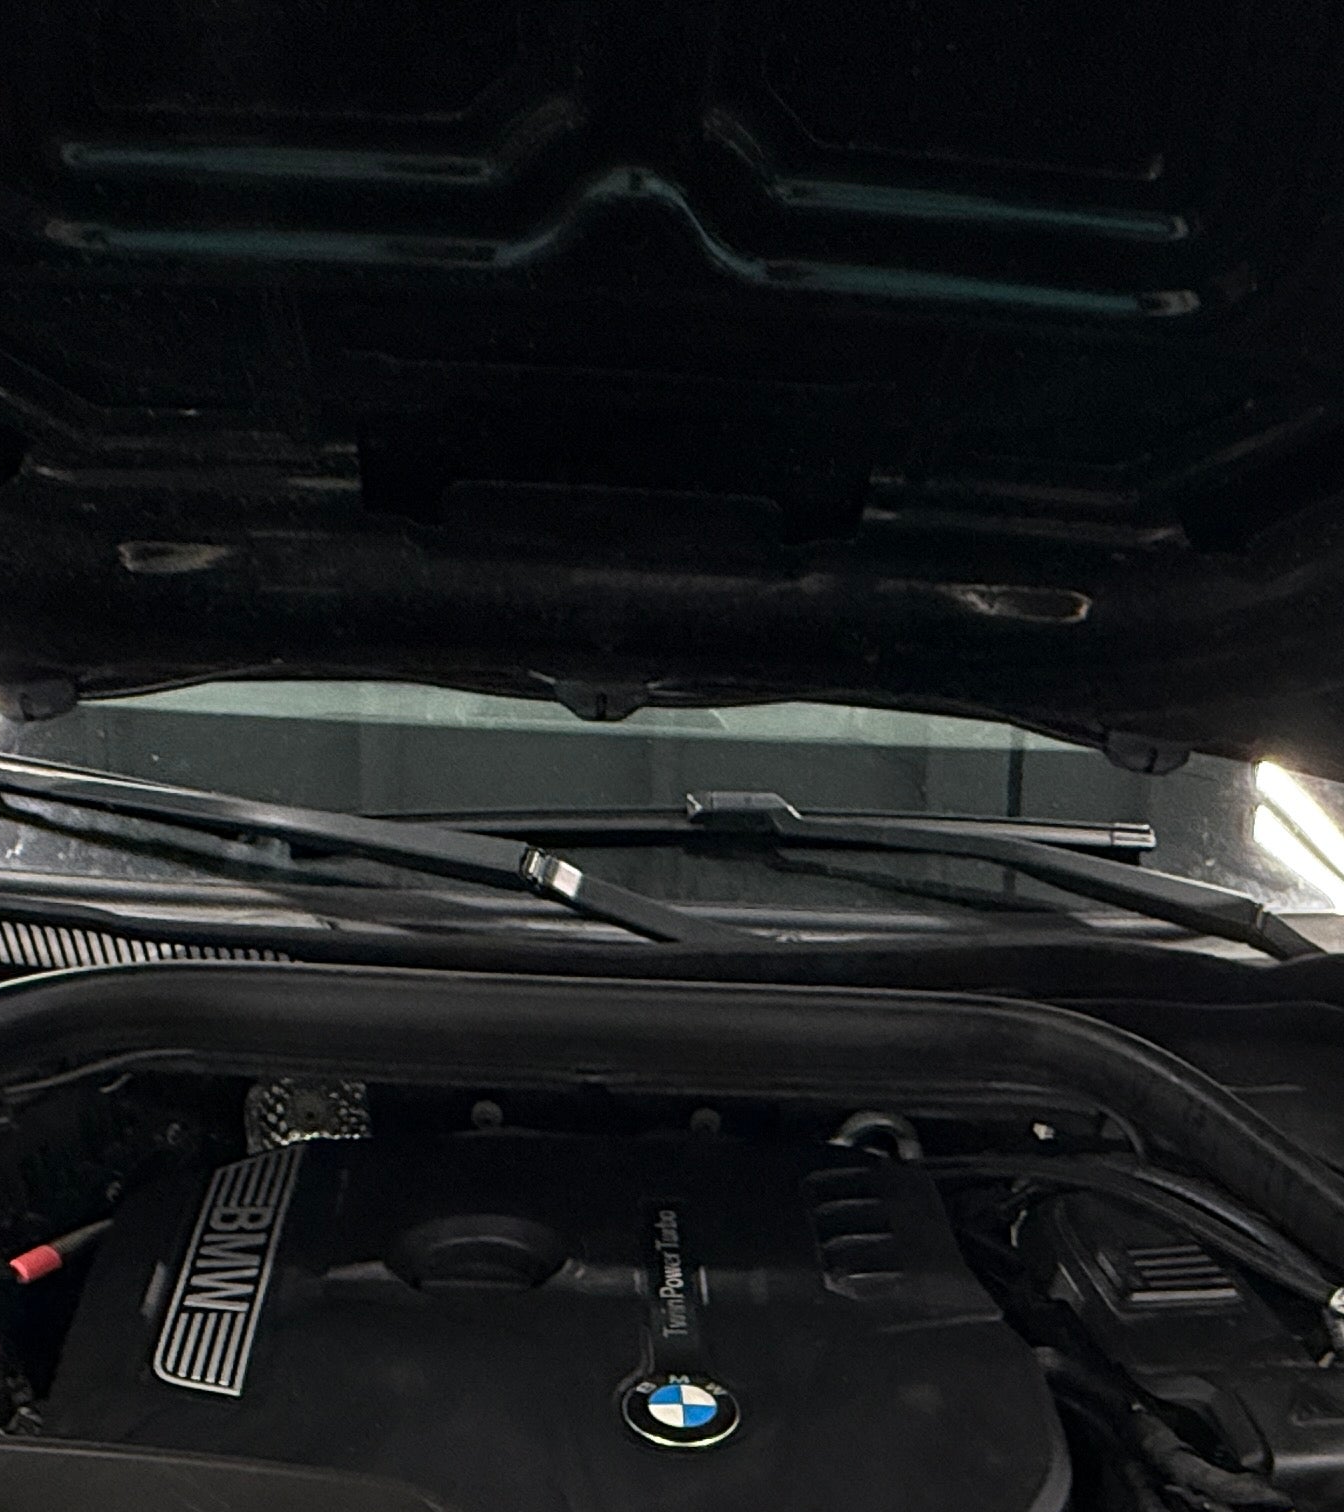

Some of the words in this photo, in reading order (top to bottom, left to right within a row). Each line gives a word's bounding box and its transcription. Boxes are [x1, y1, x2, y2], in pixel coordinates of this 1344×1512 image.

[184, 1206, 275, 1312] BMW
[655, 1210, 679, 1250] Turbo
[659, 1252, 688, 1338] TwinPower
[636, 1374, 728, 1396] BMW
